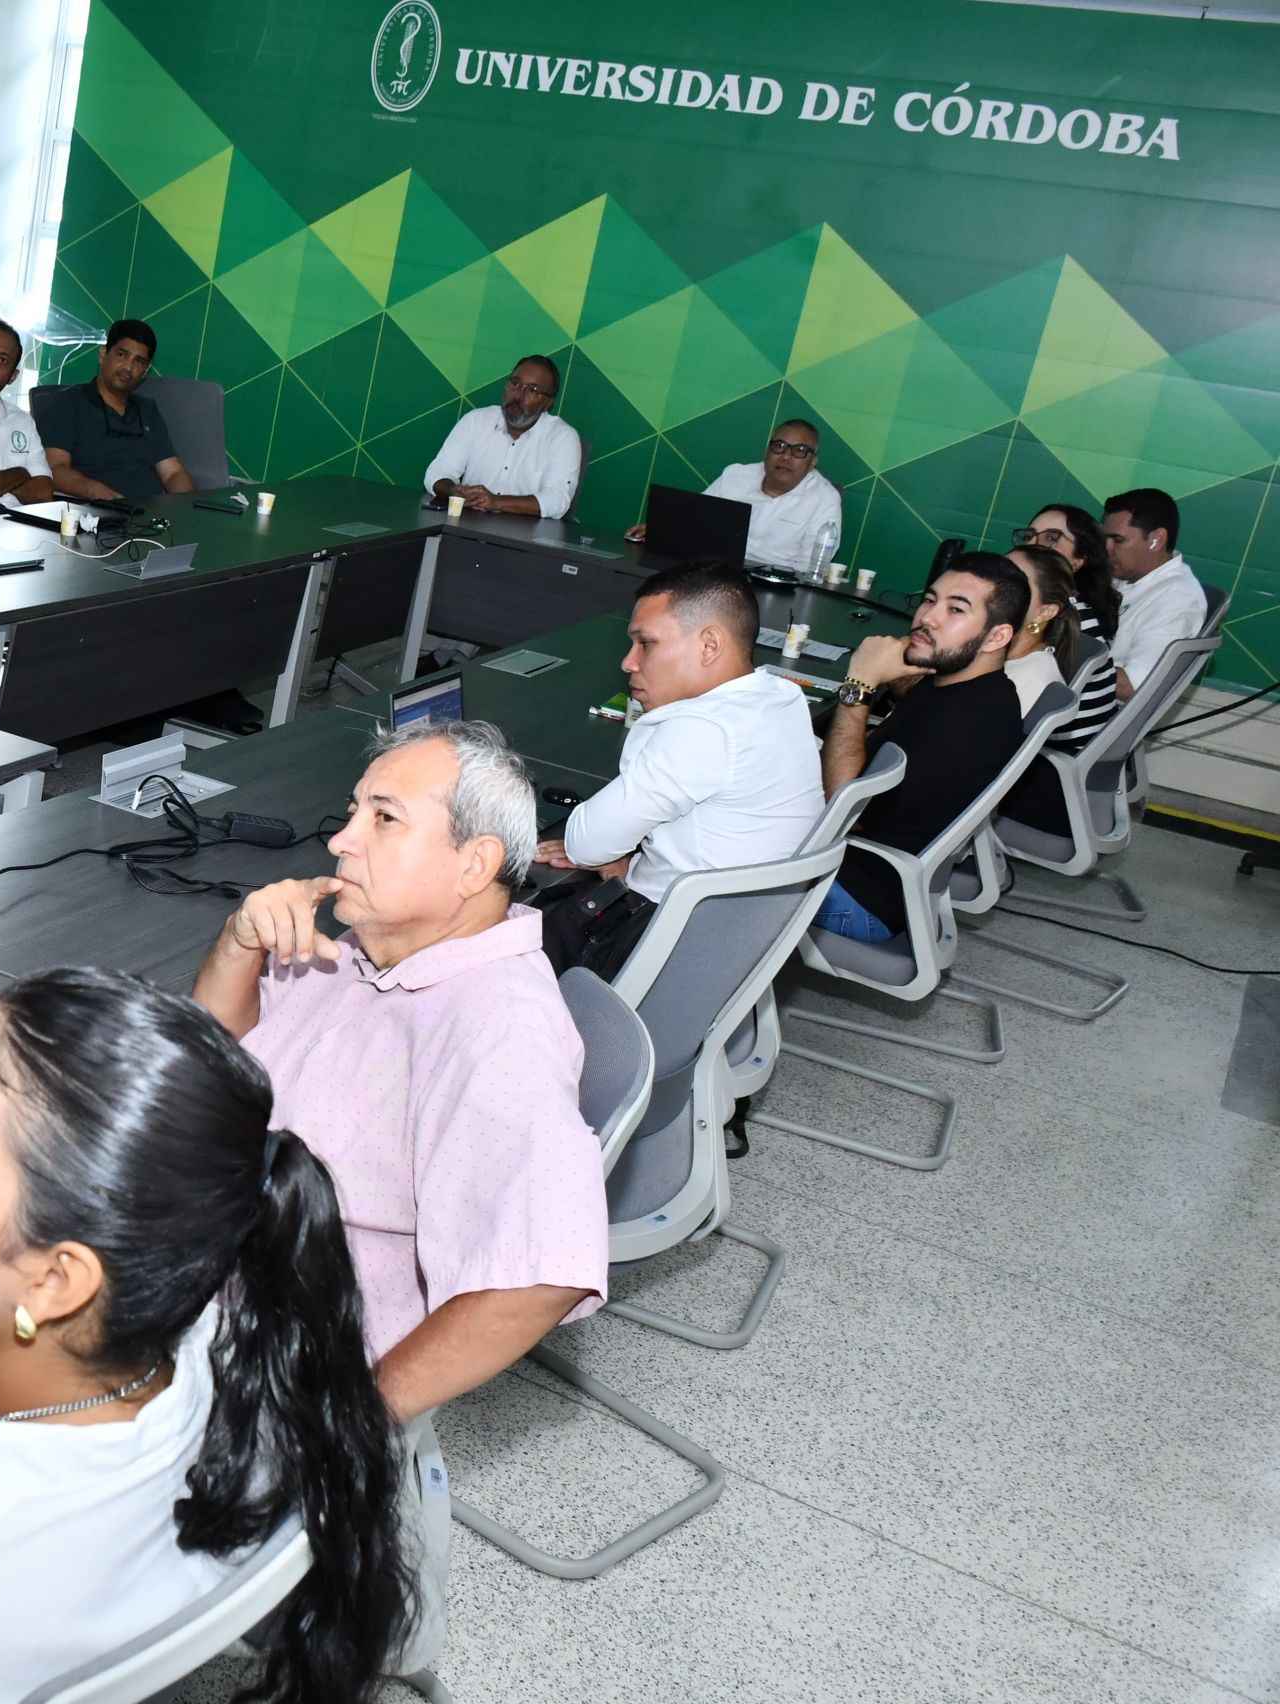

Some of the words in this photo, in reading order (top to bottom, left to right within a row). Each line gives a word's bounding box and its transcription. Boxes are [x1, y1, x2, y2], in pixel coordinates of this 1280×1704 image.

[455, 48, 783, 115] UNIVERSIDAD
[798, 82, 875, 126] DE
[894, 82, 1180, 161] CÓRDOBA
